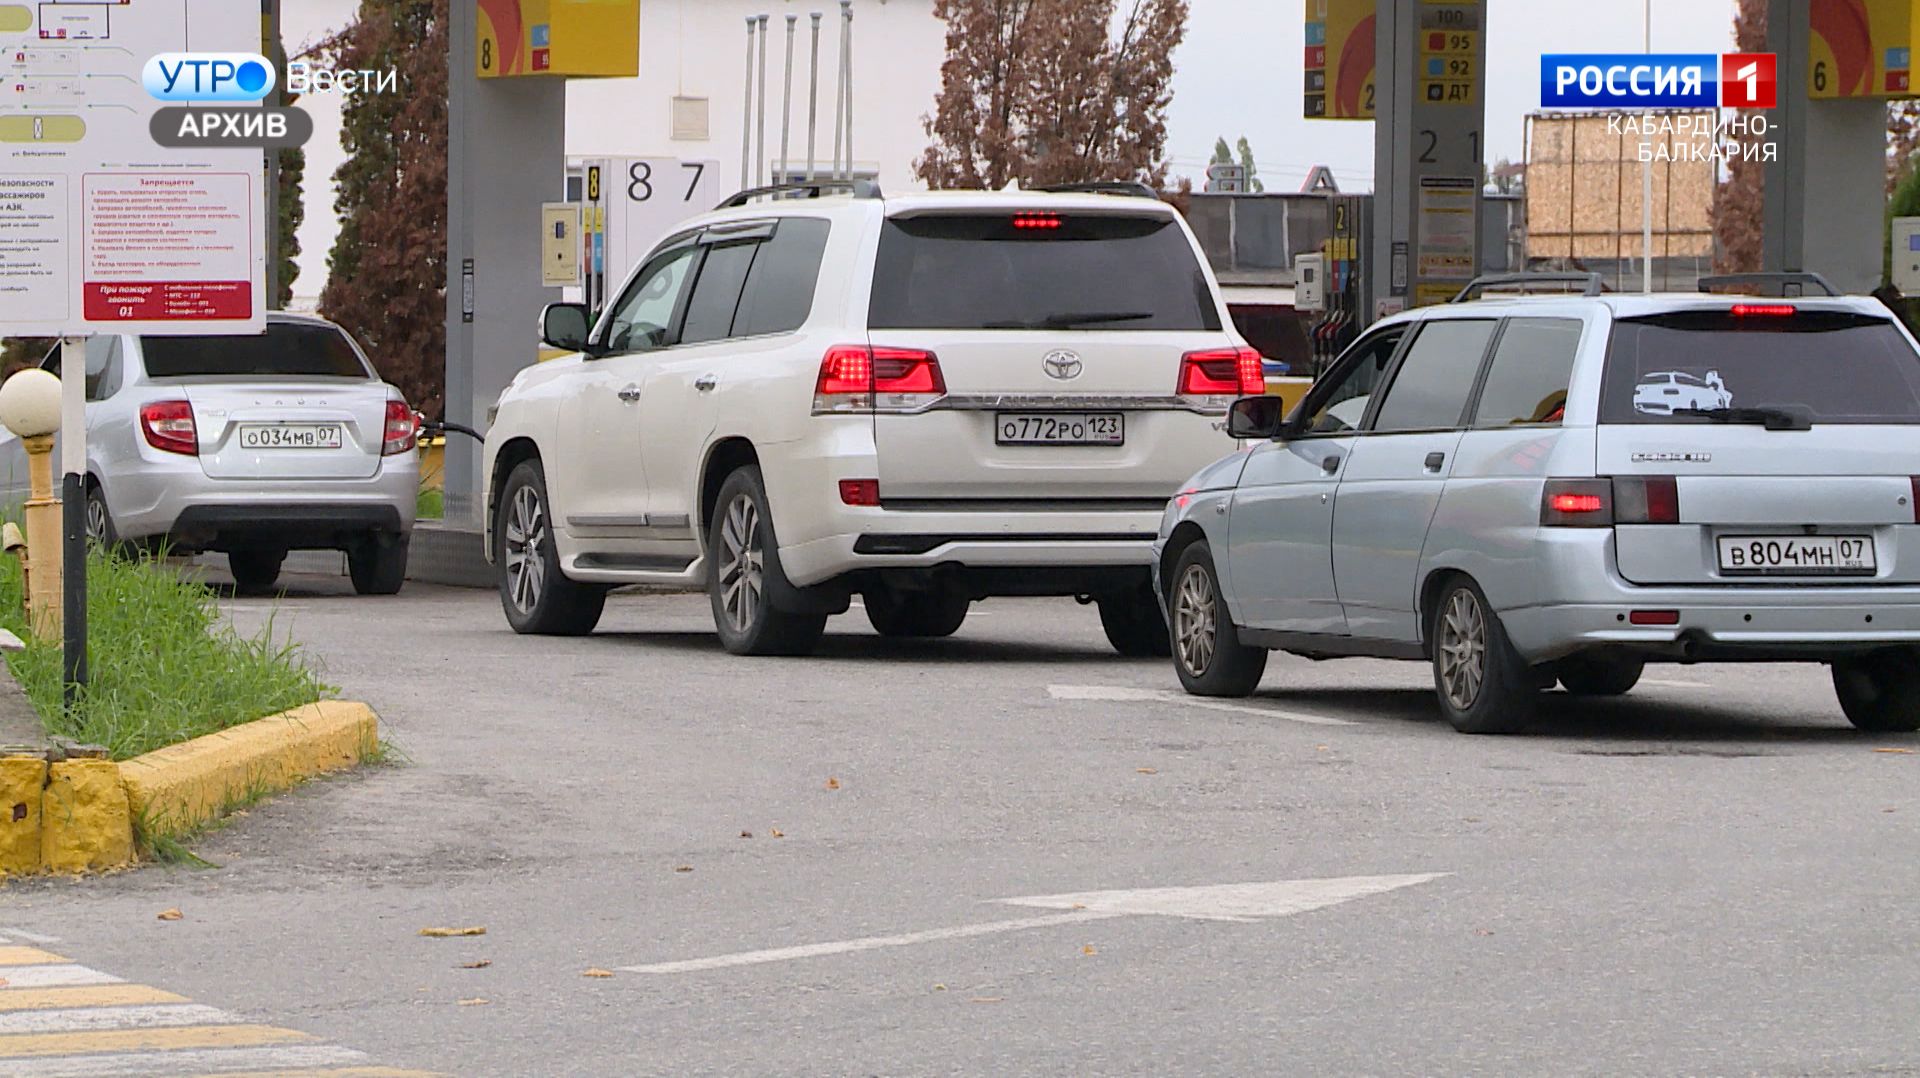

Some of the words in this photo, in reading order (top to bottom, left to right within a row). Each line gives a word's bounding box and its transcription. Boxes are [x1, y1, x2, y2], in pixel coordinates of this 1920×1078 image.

[1437, 10, 1463, 24] 100
[482, 38, 492, 70] 8
[1449, 35, 1471, 50] 95
[1449, 60, 1470, 76] 92
[1814, 61, 1826, 91] 6
[1365, 84, 1376, 110] 2
[1447, 84, 1471, 101] ДТ
[1418, 130, 1438, 163] 2
[1468, 131, 1479, 163] 1
[140, 178, 194, 188] Запрещается
[589, 168, 599, 198] 8
[628, 161, 652, 201] 8
[681, 163, 704, 201] 7
[1335, 205, 1345, 231] 2
[100, 286, 117, 295] При
[118, 286, 153, 295] пожаре
[119, 306, 134, 317] 01
[247, 429, 315, 445] О034МВ
[318, 428, 336, 441] 07
[1004, 417, 1084, 440] О772РО
[1087, 417, 1118, 434] 123
[1731, 540, 1834, 566] В804МН
[1840, 540, 1865, 559] 07
